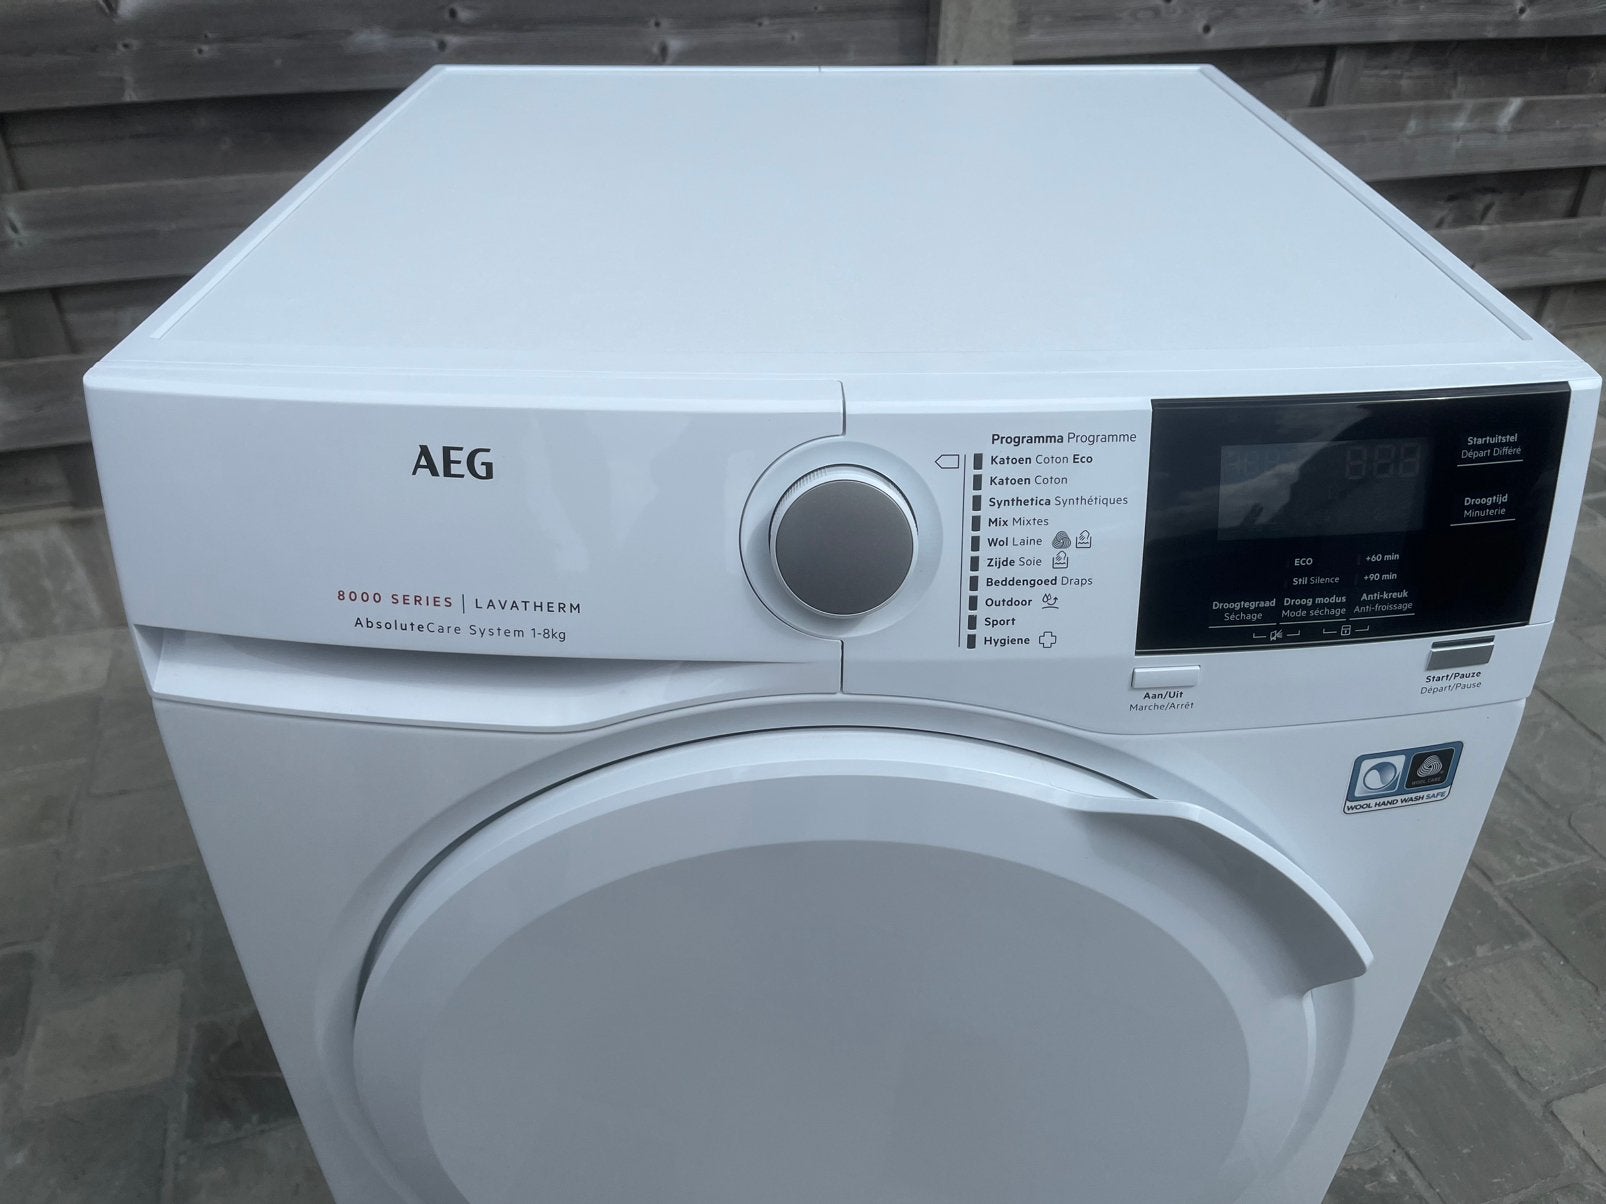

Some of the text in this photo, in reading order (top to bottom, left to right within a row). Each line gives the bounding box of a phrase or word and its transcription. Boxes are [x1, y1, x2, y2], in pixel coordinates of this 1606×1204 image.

[991, 432, 1137, 446] Programma Programme
[1467, 433, 1518, 446] Startuitstel
[990, 453, 1093, 465] Katoen Coton Eco
[1461, 449, 1491, 460] Départ
[411, 444, 494, 480] AEG
[989, 475, 1068, 486] Katoen Coton
[989, 495, 1129, 509] Synthetica Synthétiques
[1464, 493, 1508, 506] Droogtijd
[1463, 507, 1506, 518] Minuterie
[988, 517, 1049, 527] Mix Mixtes
[987, 537, 1043, 547] Wol Laine
[986, 557, 1042, 569] Zijde Soie
[1294, 558, 1313, 566] ECO
[1365, 552, 1400, 563] +60 min
[986, 576, 1093, 589] Beddengoed Draps
[1292, 576, 1340, 586] Stil Silence
[1363, 572, 1397, 582] +90 min
[1283, 594, 1347, 608] Droog modus
[1360, 589, 1409, 602] Anti-kreuk
[337, 590, 581, 614] 8000 SERIES LAVATHERM
[985, 597, 1033, 607] Outdoor
[1212, 598, 1276, 611] Droogtegraad
[1353, 601, 1413, 614] Anti-froissage
[1224, 611, 1263, 622] Séchage
[1281, 606, 1347, 618] Mode séchage
[984, 617, 1016, 629] Sport
[354, 617, 566, 642] AbsoluteCare System 1-8kg
[984, 636, 1030, 647] Hygiene
[1425, 671, 1482, 683] Start/Pauze
[1420, 681, 1482, 695] Départ/Pause
[1143, 690, 1184, 700] Aan/Uit
[1129, 701, 1194, 712] Marche/Arrêt
[1346, 791, 1446, 812] WOOL HAND WASH SAFE
